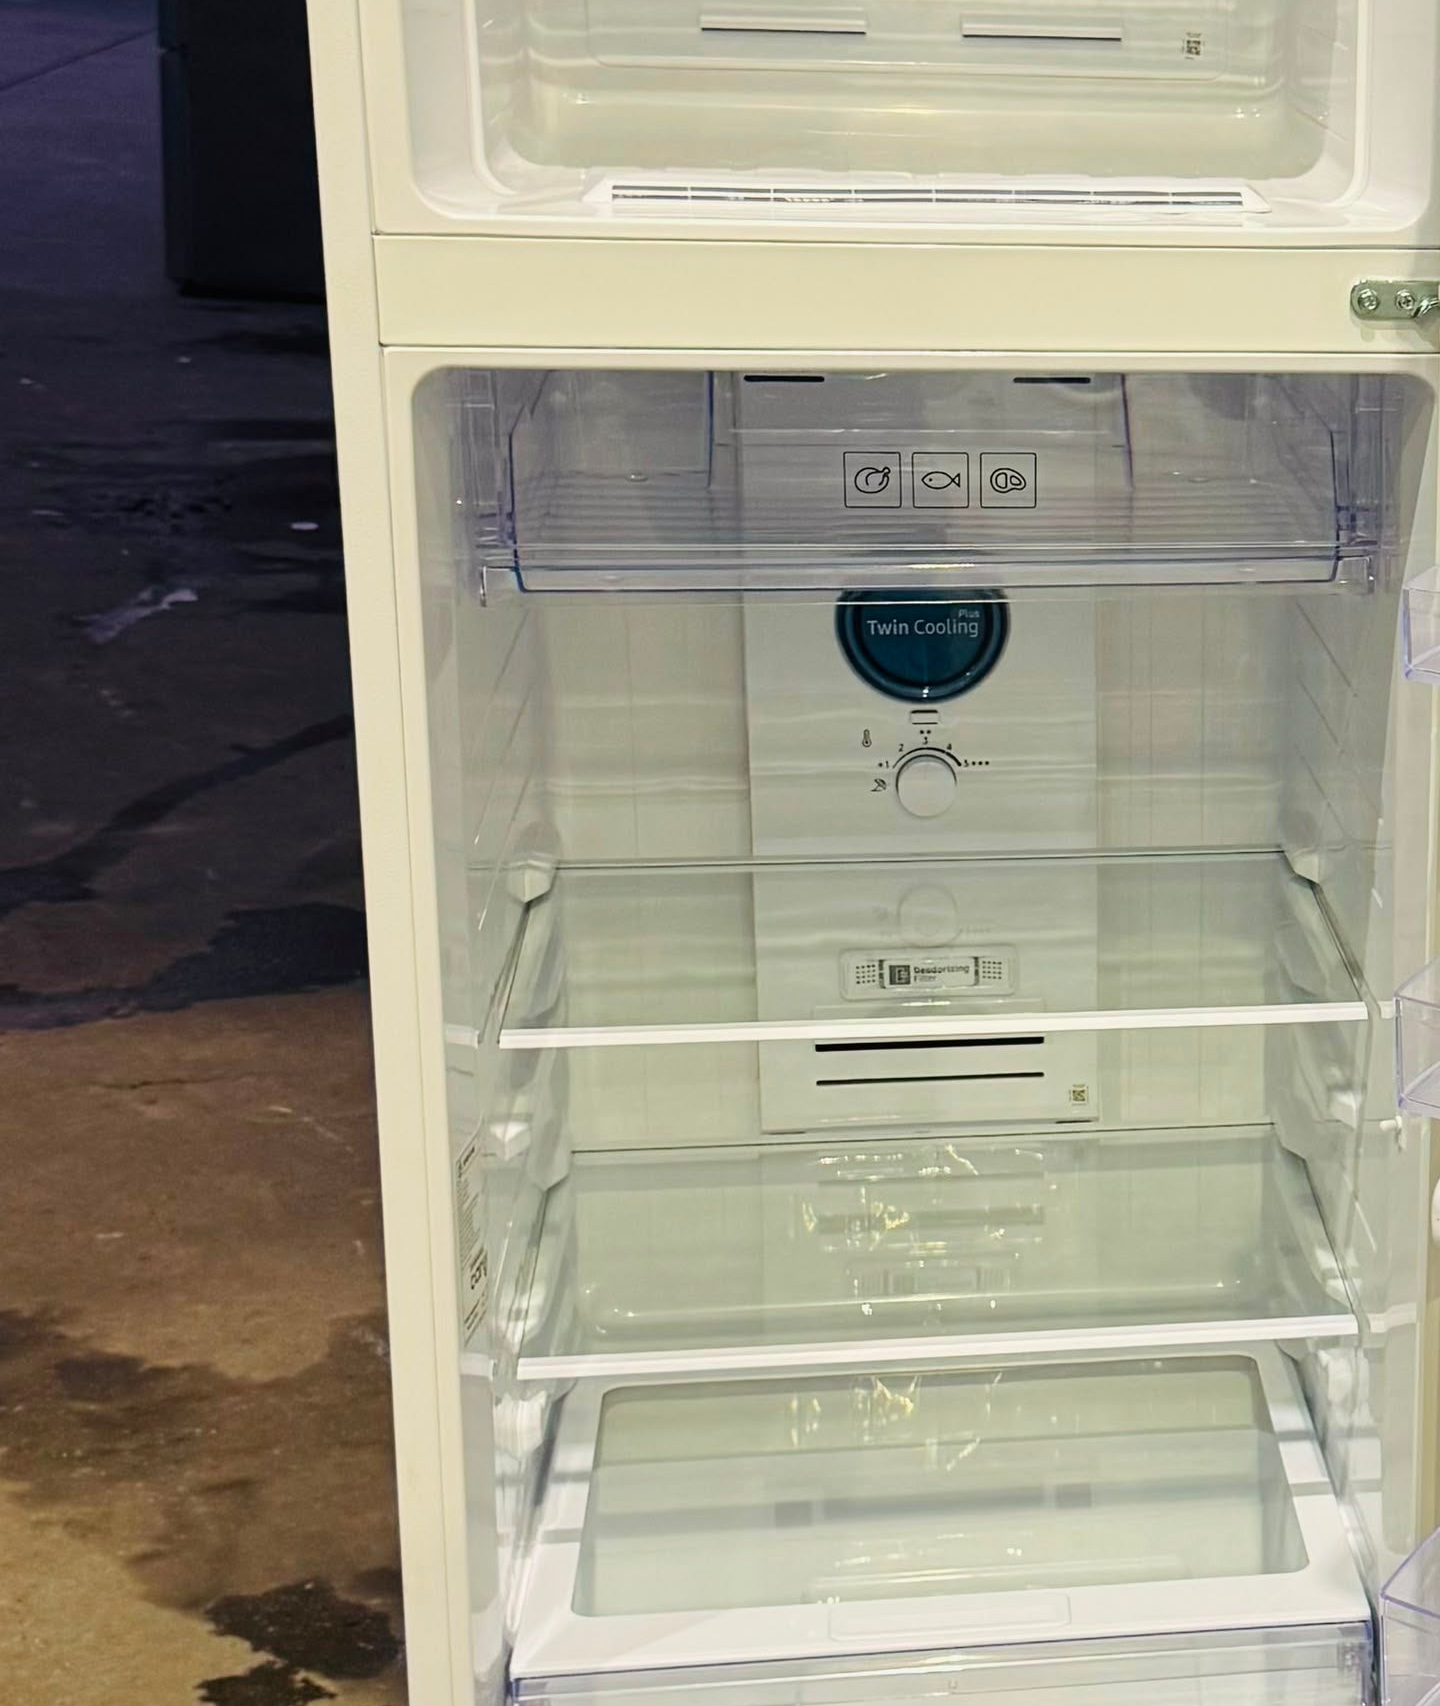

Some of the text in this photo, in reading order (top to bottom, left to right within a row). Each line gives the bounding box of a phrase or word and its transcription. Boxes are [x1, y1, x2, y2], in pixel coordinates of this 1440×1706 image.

[958, 609, 980, 618] Plus
[866, 618, 979, 638] Twin Cooling
[898, 743, 904, 752] 2
[922, 736, 929, 745] 3
